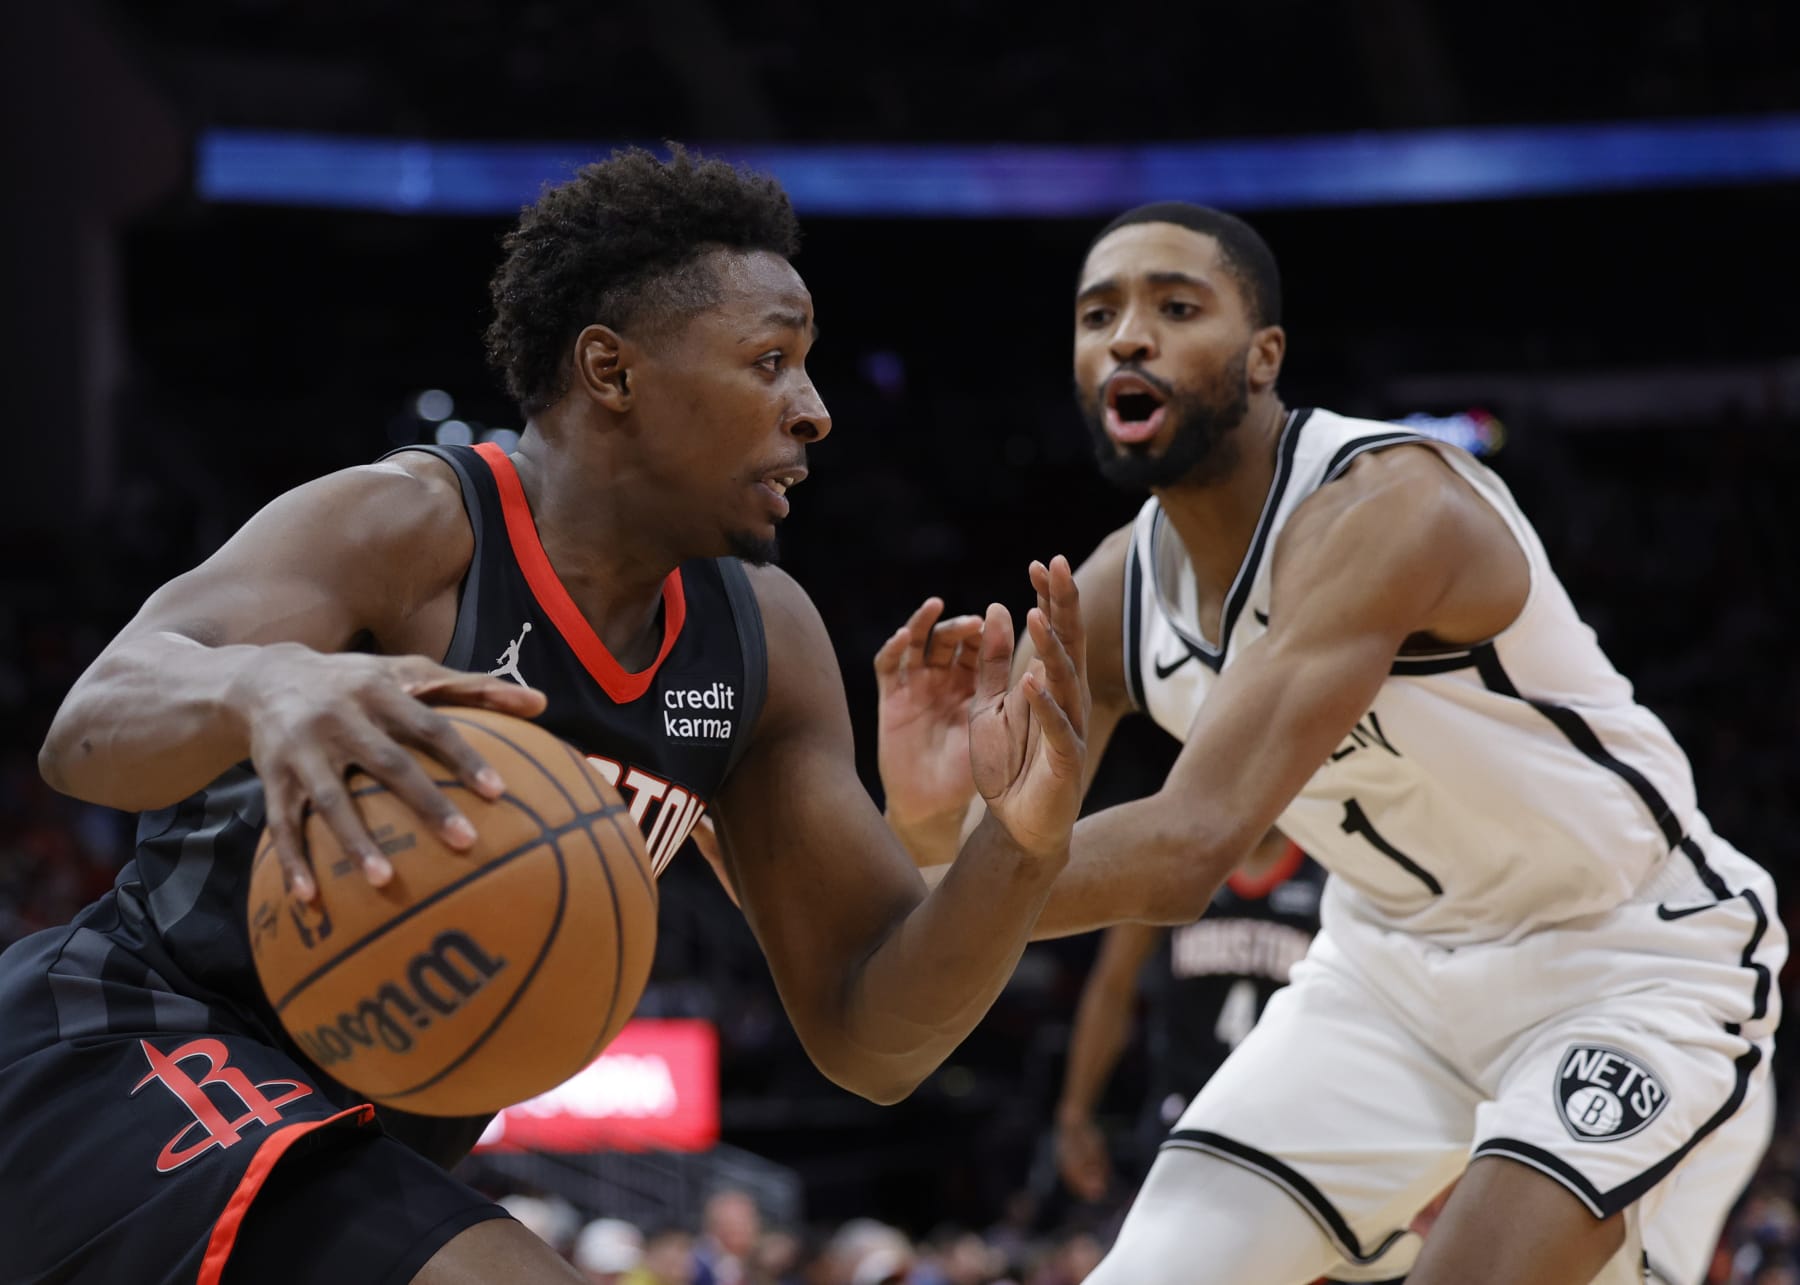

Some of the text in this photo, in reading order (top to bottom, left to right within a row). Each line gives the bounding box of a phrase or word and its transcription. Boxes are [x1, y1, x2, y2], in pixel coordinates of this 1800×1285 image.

[664, 682, 735, 710] credit
[664, 711, 732, 739] karma
[1340, 797, 1444, 896] 1
[299, 929, 508, 1067] Wilson
[1562, 1048, 1663, 1120] NETS
[1580, 1094, 1608, 1127] B
